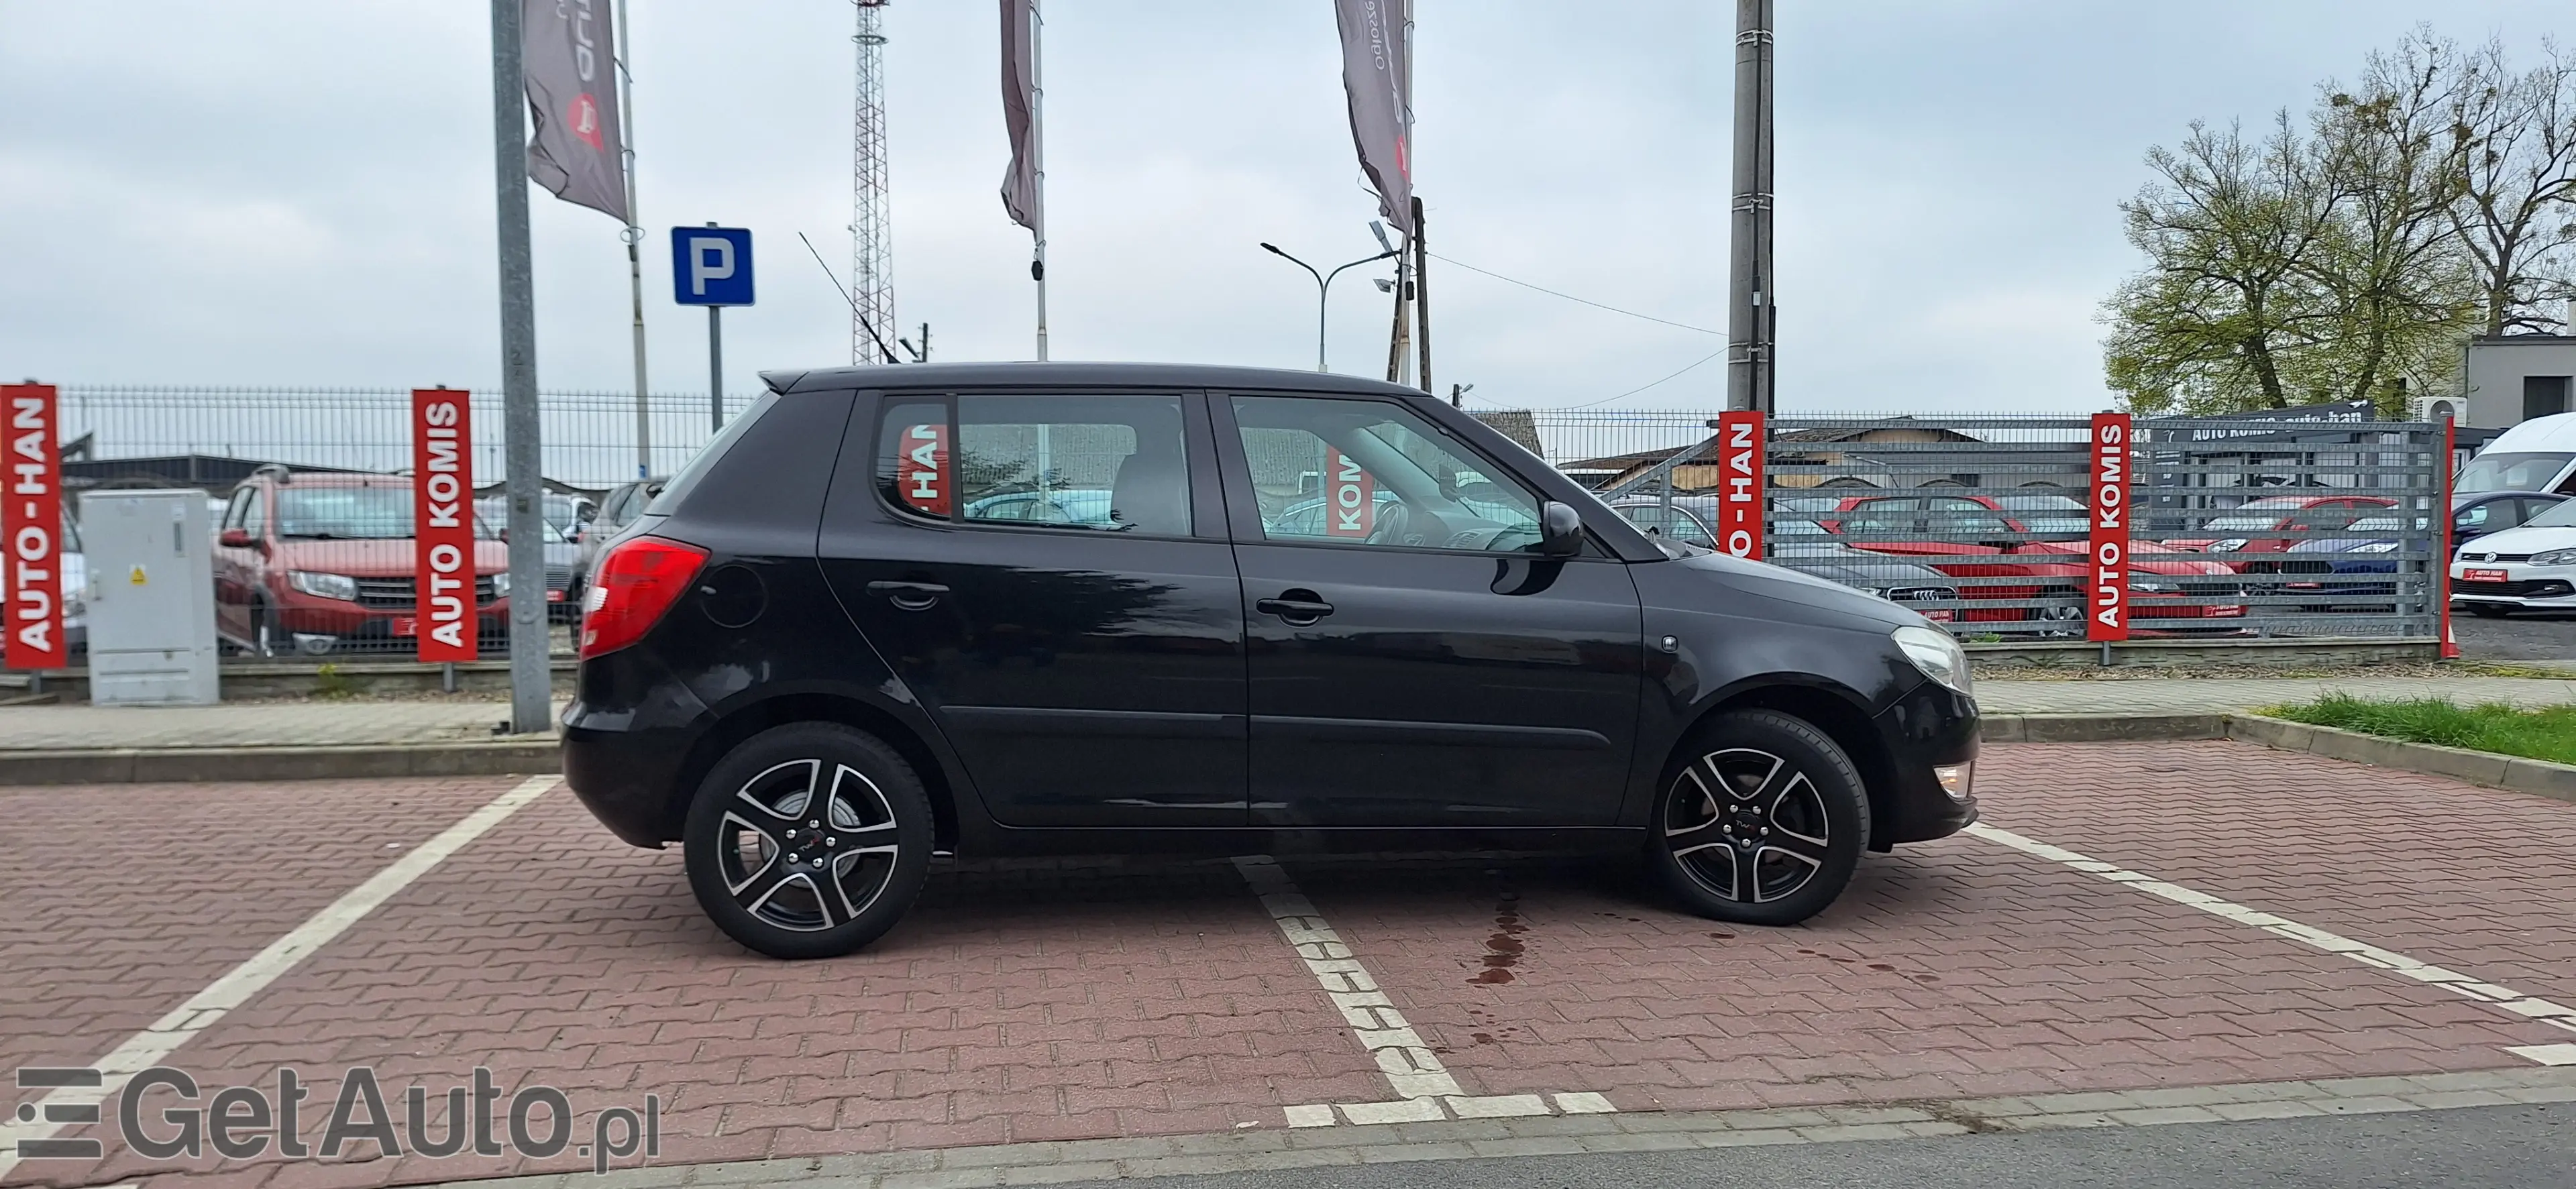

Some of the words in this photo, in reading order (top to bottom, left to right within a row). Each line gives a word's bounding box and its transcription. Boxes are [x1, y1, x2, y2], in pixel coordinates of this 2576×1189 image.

[690, 237, 735, 295] P
[425, 402, 460, 528] KOMIS
[1338, 454, 1362, 530] KOM
[1729, 423, 1753, 557] O-HAN
[2100, 424, 2122, 528] KOMIS
[429, 543, 464, 648] AUTO
[2098, 542, 2120, 628] AUTO
